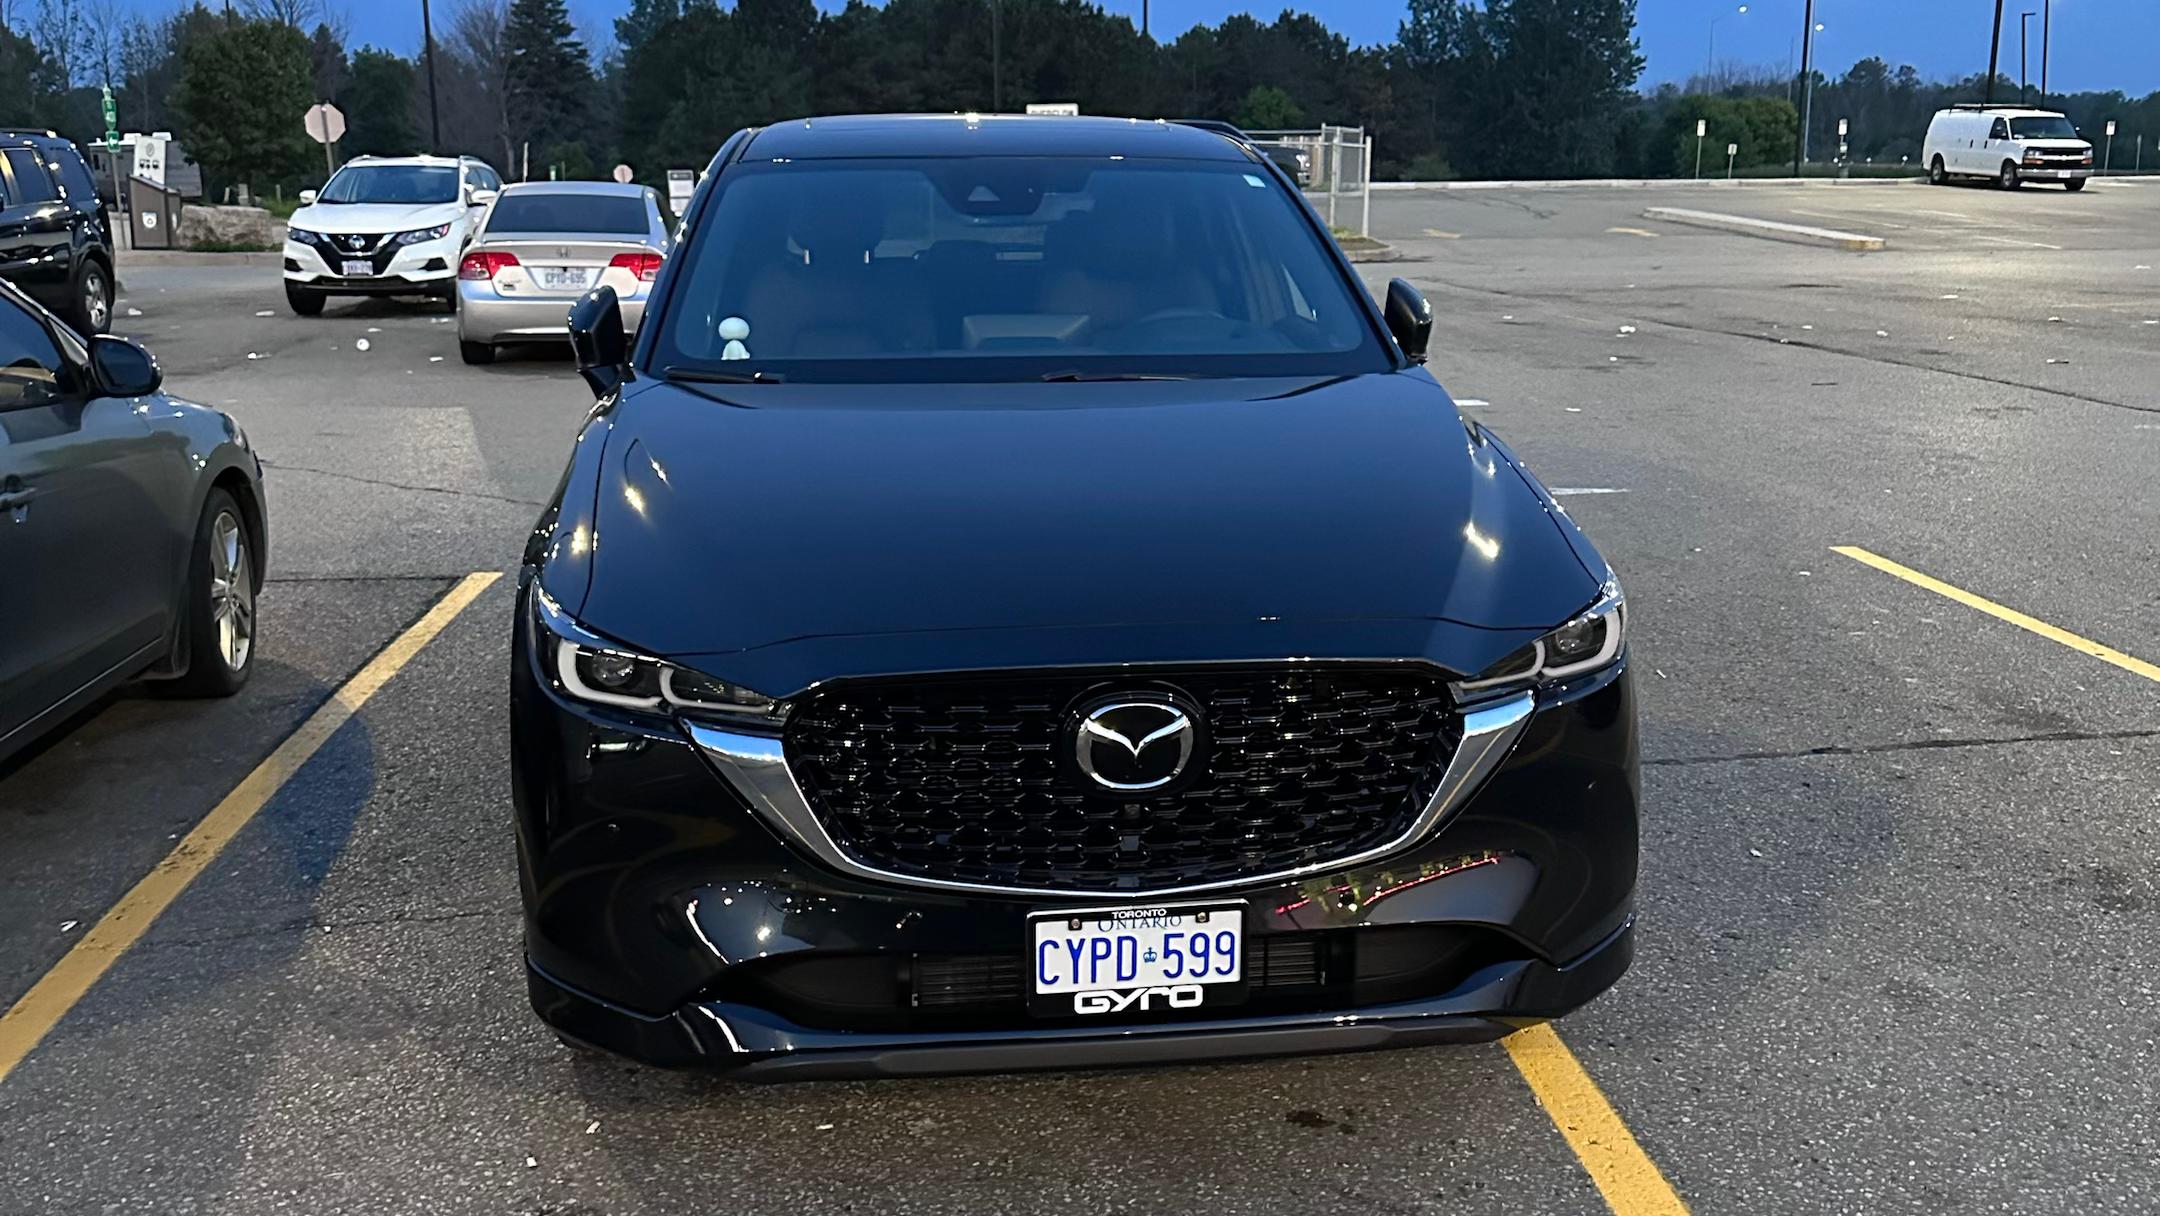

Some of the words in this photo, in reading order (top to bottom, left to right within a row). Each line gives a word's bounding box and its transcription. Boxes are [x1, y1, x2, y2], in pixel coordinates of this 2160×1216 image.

[1112, 908, 1167, 919] TORONTO
[1098, 915, 1182, 932] ONTARIO
[1039, 935, 1138, 985] CYPD
[1163, 931, 1235, 978] 599
